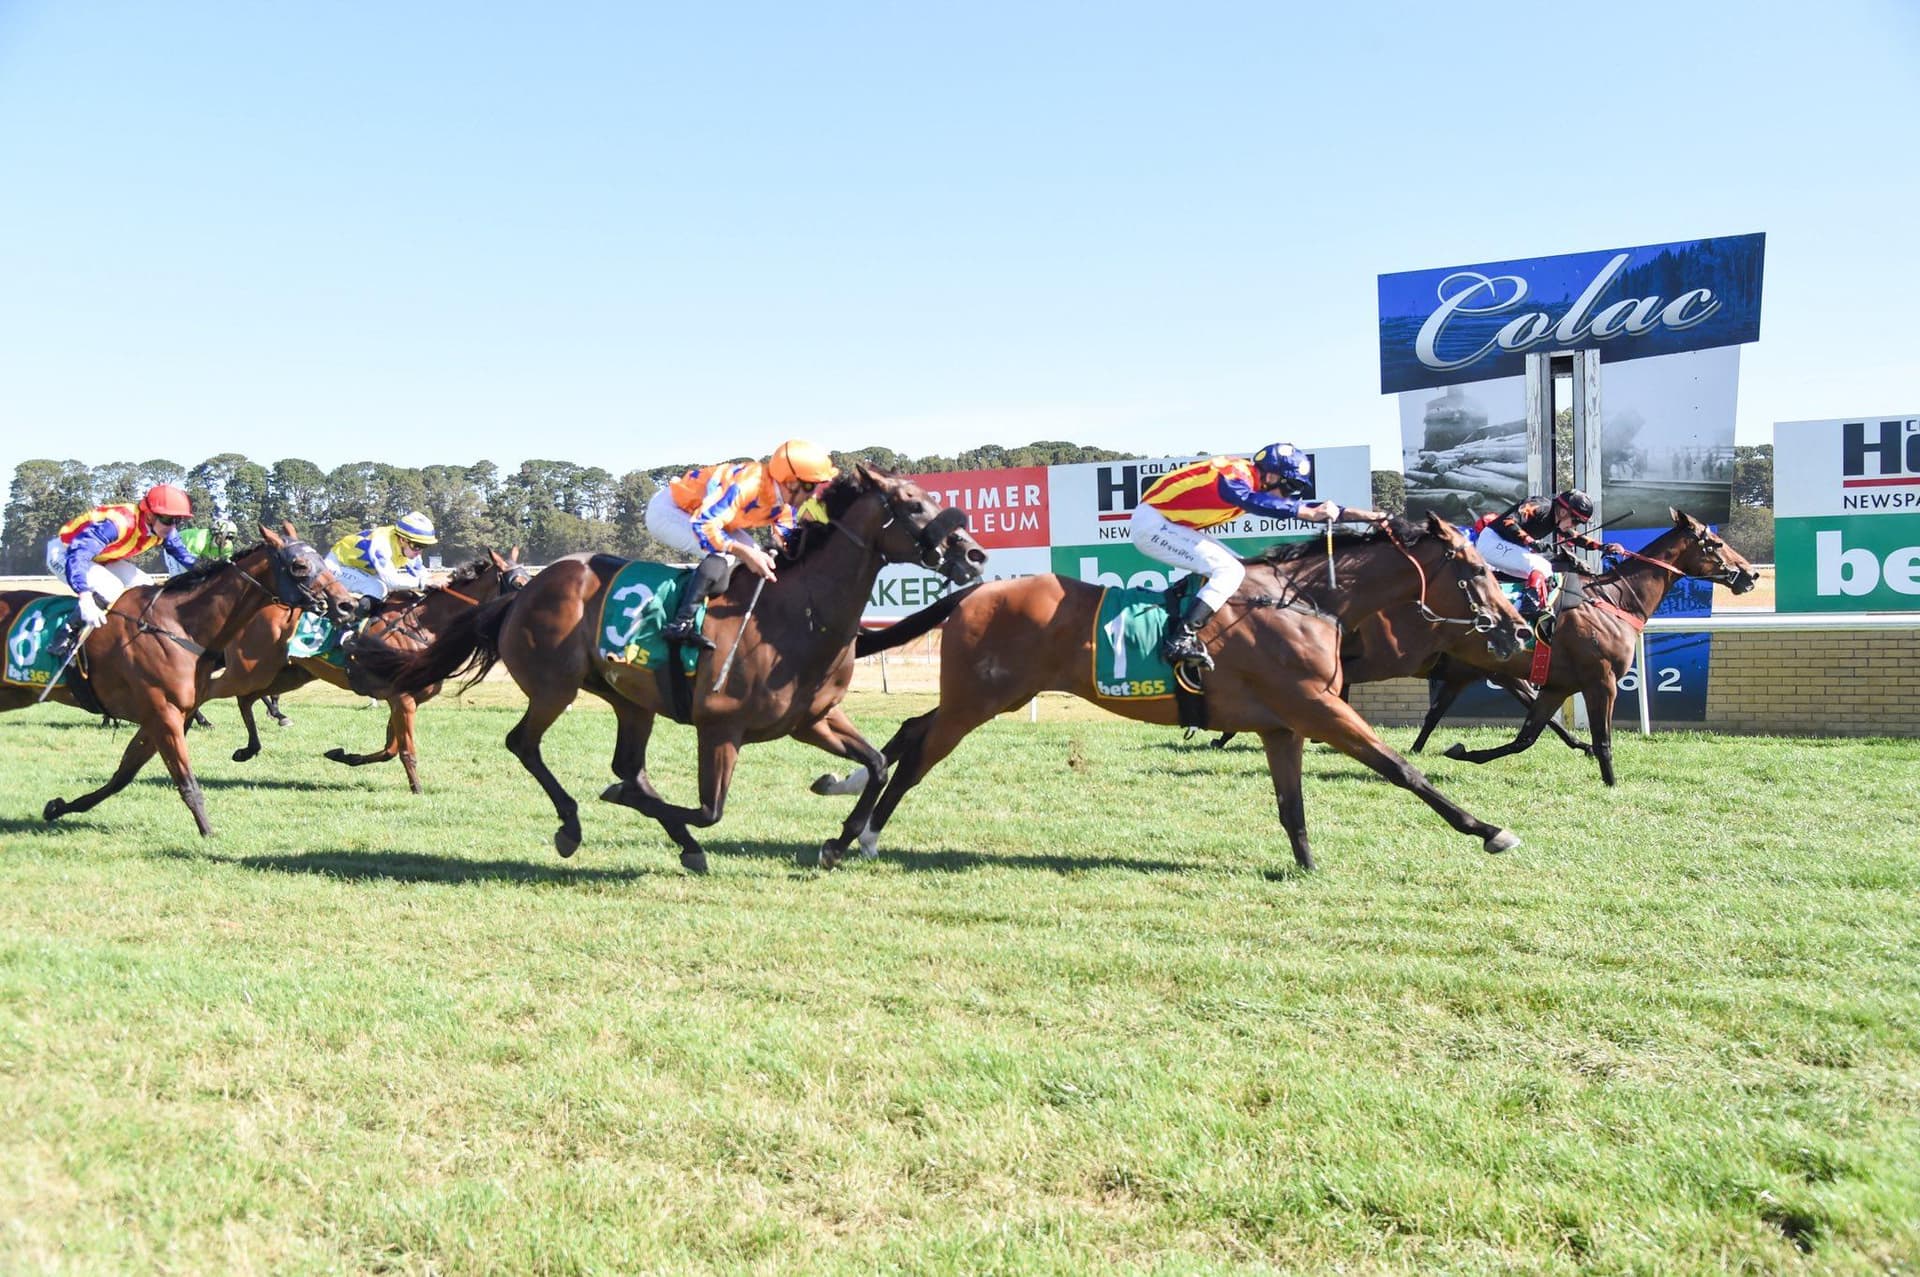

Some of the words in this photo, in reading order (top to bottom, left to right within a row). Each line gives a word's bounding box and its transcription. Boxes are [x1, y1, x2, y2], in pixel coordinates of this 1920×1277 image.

[1415, 253, 1720, 371] Colac
[1243, 520, 1253, 532] &
[1260, 517, 1317, 532] DIGITAL
[606, 583, 654, 646] 3
[1104, 607, 1127, 679] 1
[1097, 680, 1166, 696] bet365
